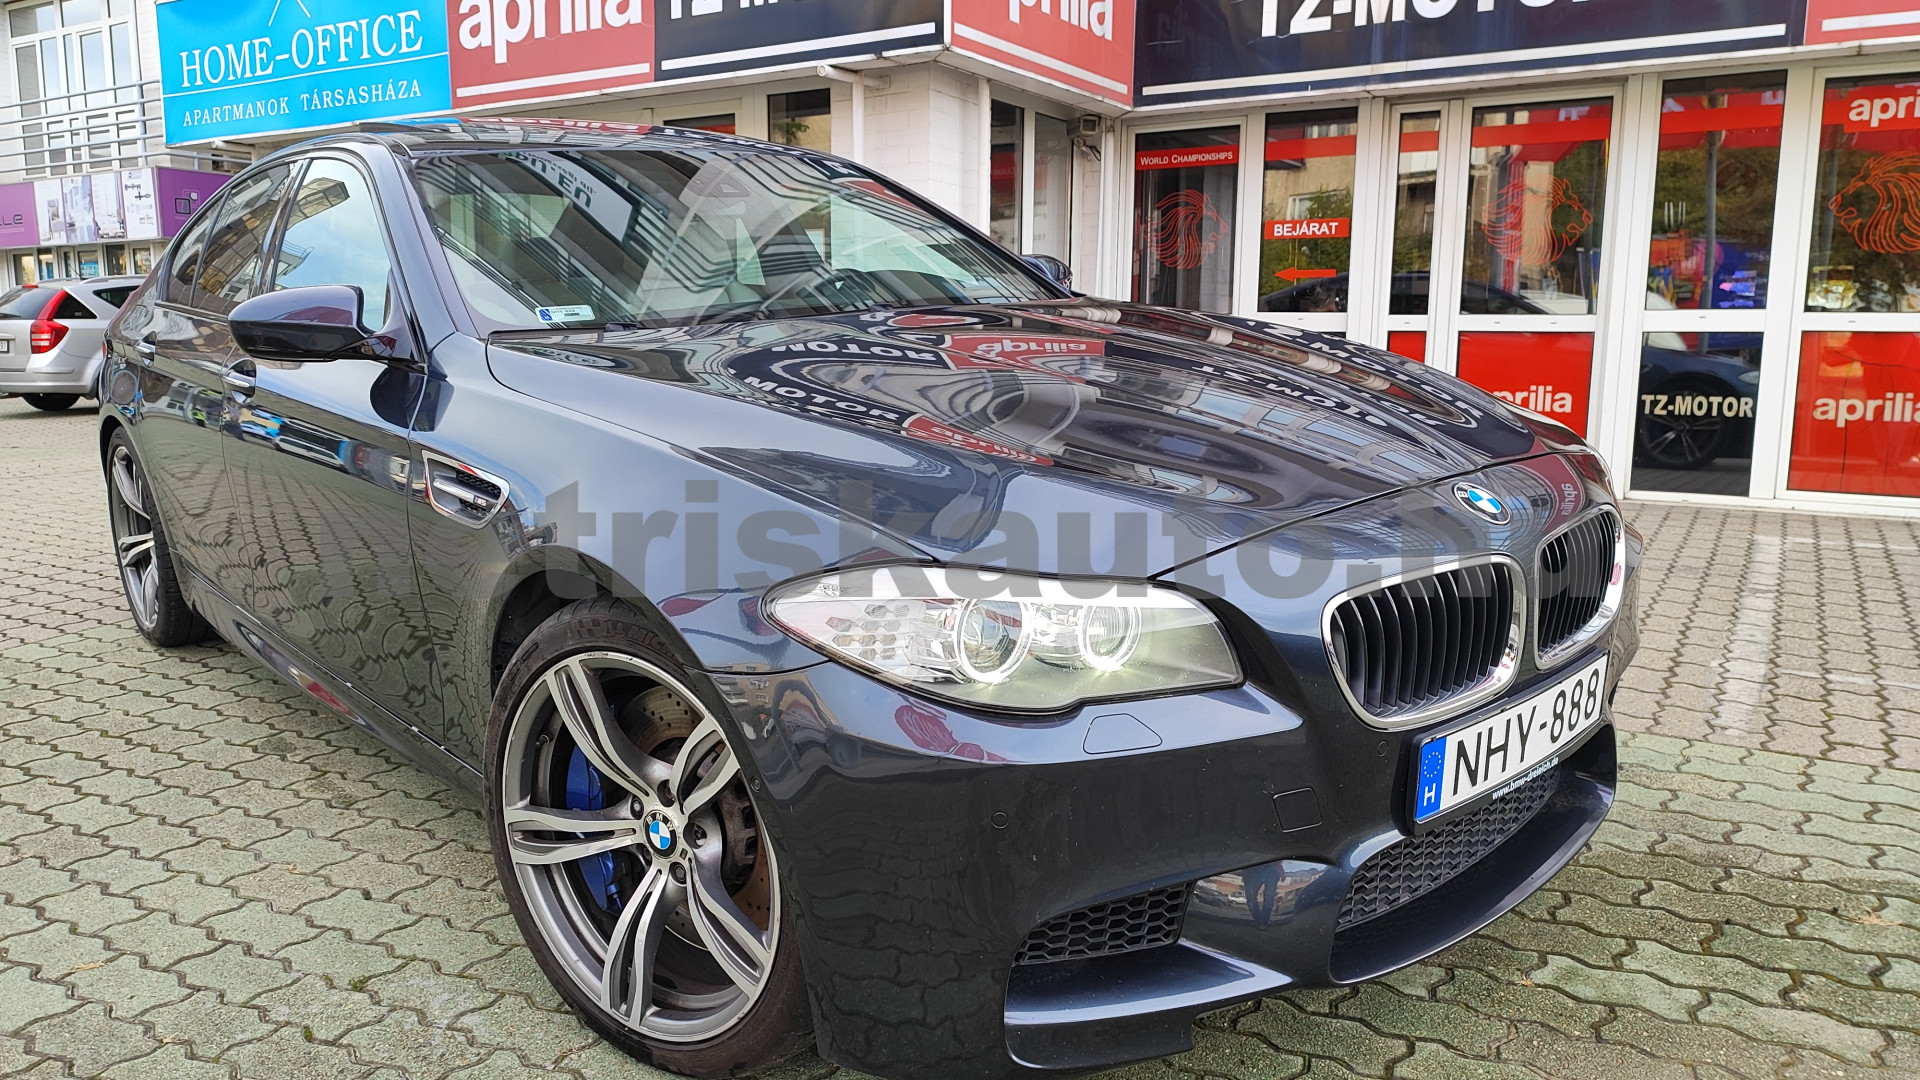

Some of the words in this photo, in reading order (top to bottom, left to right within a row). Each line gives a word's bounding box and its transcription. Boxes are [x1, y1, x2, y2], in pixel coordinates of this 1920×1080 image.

[179, 9, 424, 88] HOME-OFFICE
[182, 96, 291, 127] APARTMANOK
[300, 78, 422, 112] TÁRSASHÁZA
[1140, 156, 1169, 166] WORLD
[1171, 151, 1233, 164] CHAMPIONSHIPS
[1273, 221, 1339, 237] BEJÁRAT
[1641, 395, 1754, 418] TZ-MOTOR
[1452, 668, 1600, 797] NHY-888
[1423, 783, 1437, 807] H
[646, 812, 676, 832] BMW
